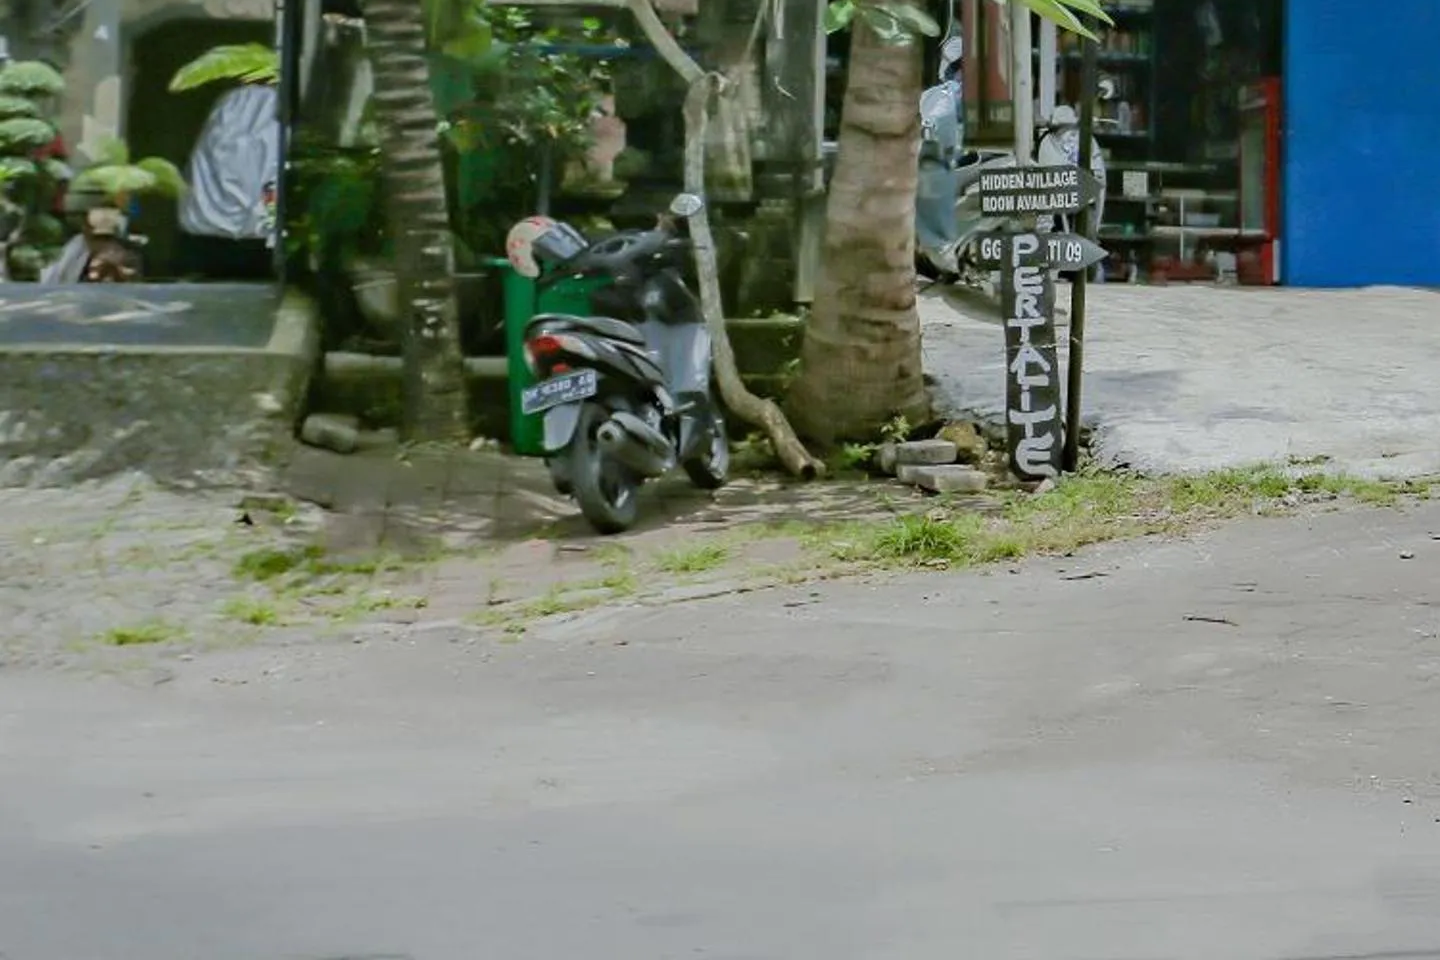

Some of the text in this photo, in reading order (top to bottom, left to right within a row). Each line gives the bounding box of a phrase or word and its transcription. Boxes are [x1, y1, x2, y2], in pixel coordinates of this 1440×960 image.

[981, 170, 1078, 191] HIDDEN VILLAGE
[1016, 191, 1079, 211] AVAILABLE
[1065, 242, 1082, 262] 09
[1008, 234, 1058, 477] PERTALITE
